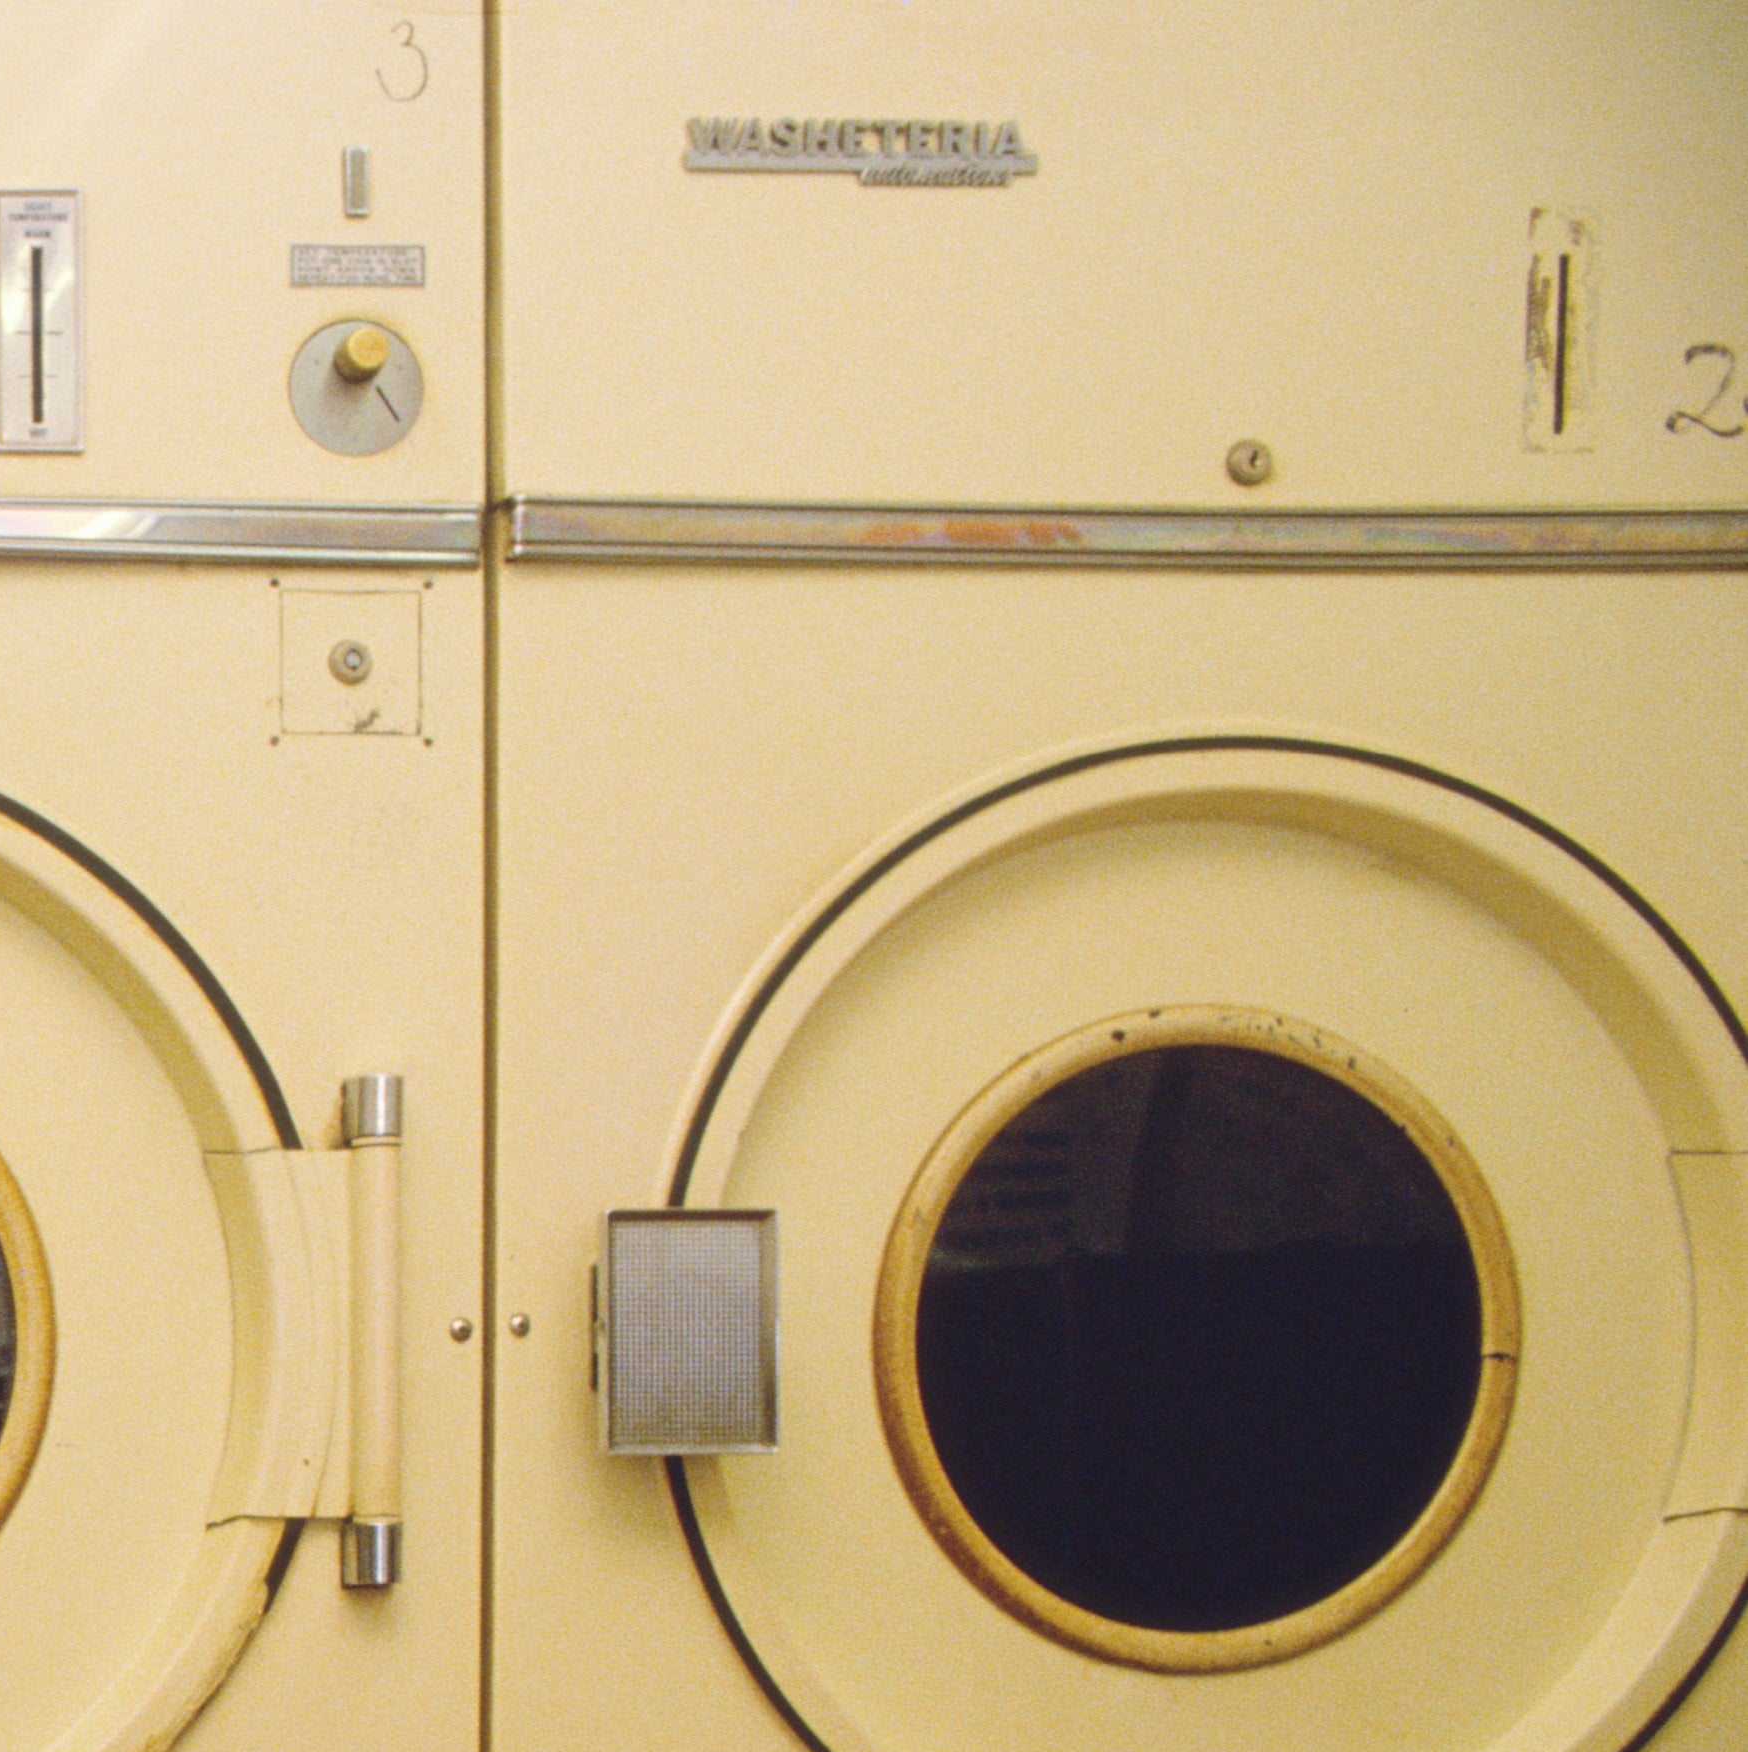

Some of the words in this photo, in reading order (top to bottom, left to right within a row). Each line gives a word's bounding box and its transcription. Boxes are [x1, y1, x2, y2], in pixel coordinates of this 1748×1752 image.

[375, 20, 429, 102] 3
[686, 117, 1026, 157] WASHETERIA
[1665, 342, 1744, 438] 2
